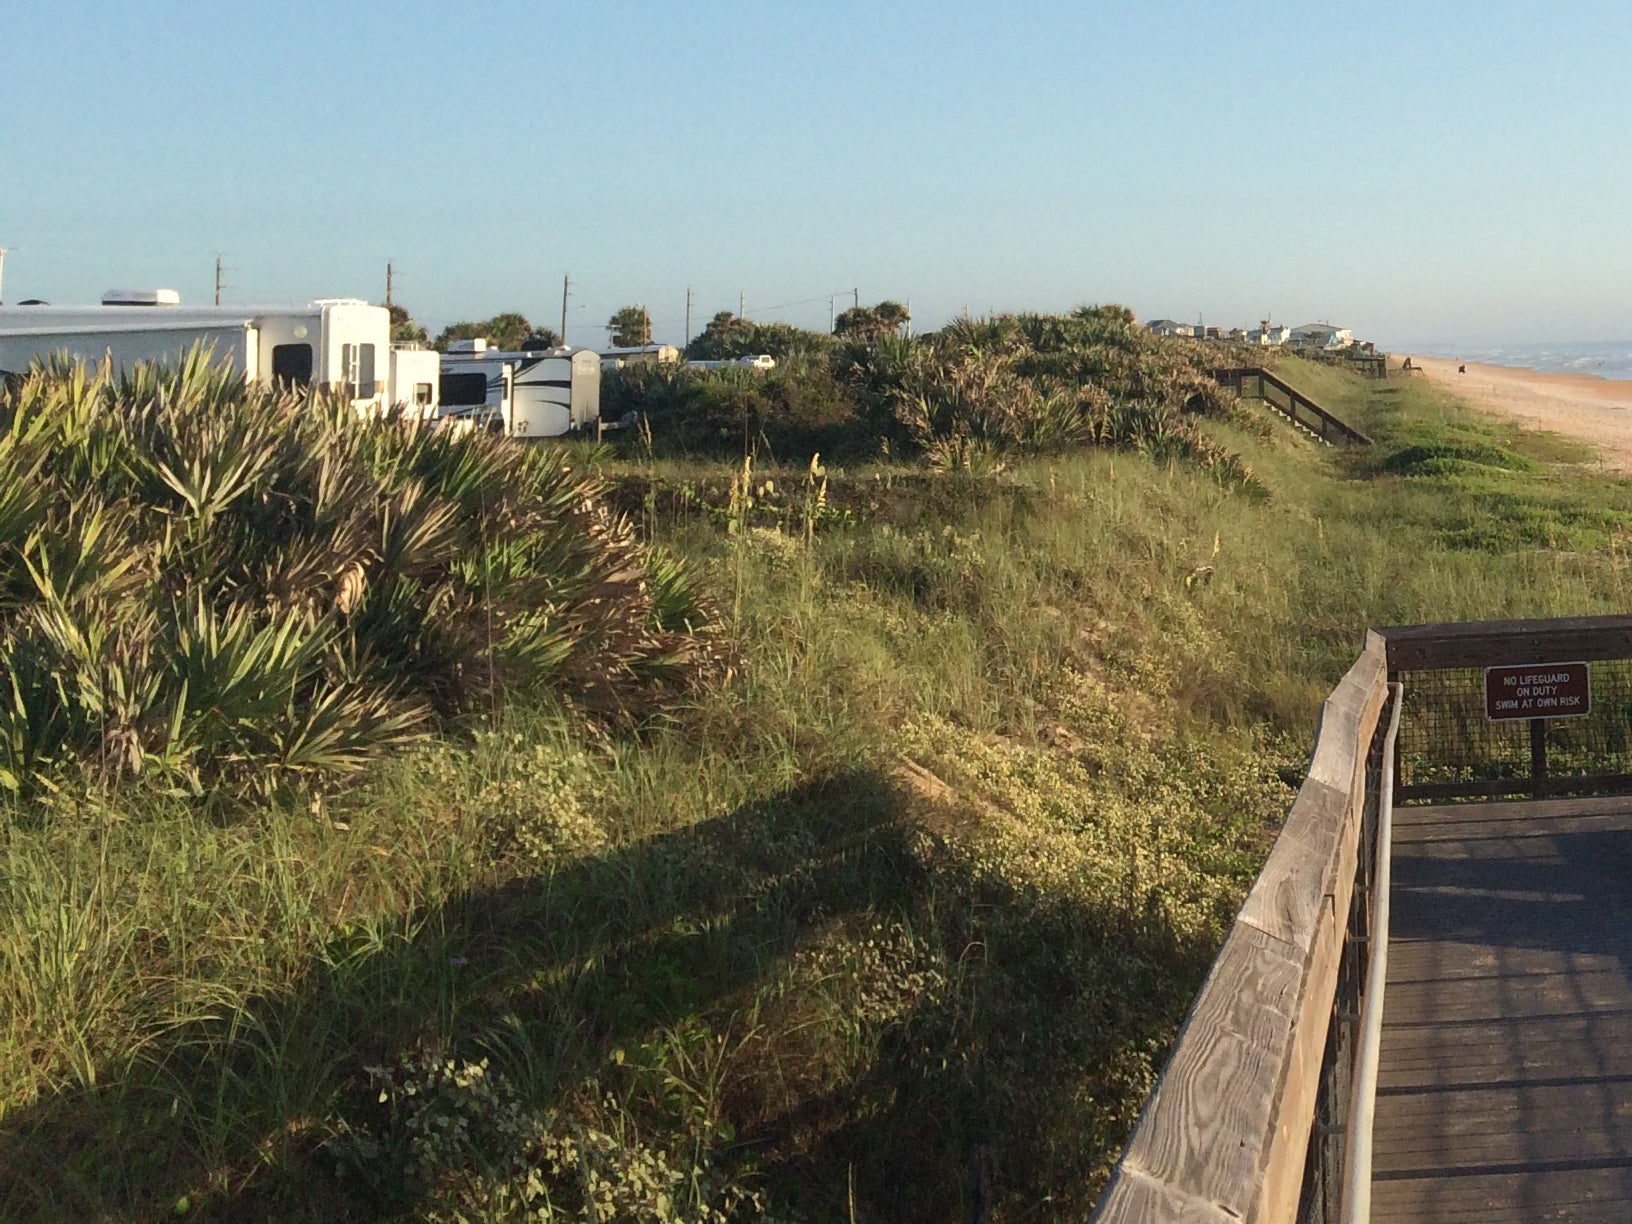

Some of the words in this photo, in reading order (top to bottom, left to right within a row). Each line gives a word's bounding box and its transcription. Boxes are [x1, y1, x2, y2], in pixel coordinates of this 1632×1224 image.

[1503, 676, 1517, 686] NO
[1519, 673, 1570, 685] LIFEGUARD
[1516, 687, 1530, 697] ON
[1532, 686, 1558, 696] DUTY
[1495, 699, 1519, 710] SWIM
[1521, 699, 1533, 709] AT
[1537, 697, 1558, 708] OWN
[1559, 696, 1581, 706] RISK
